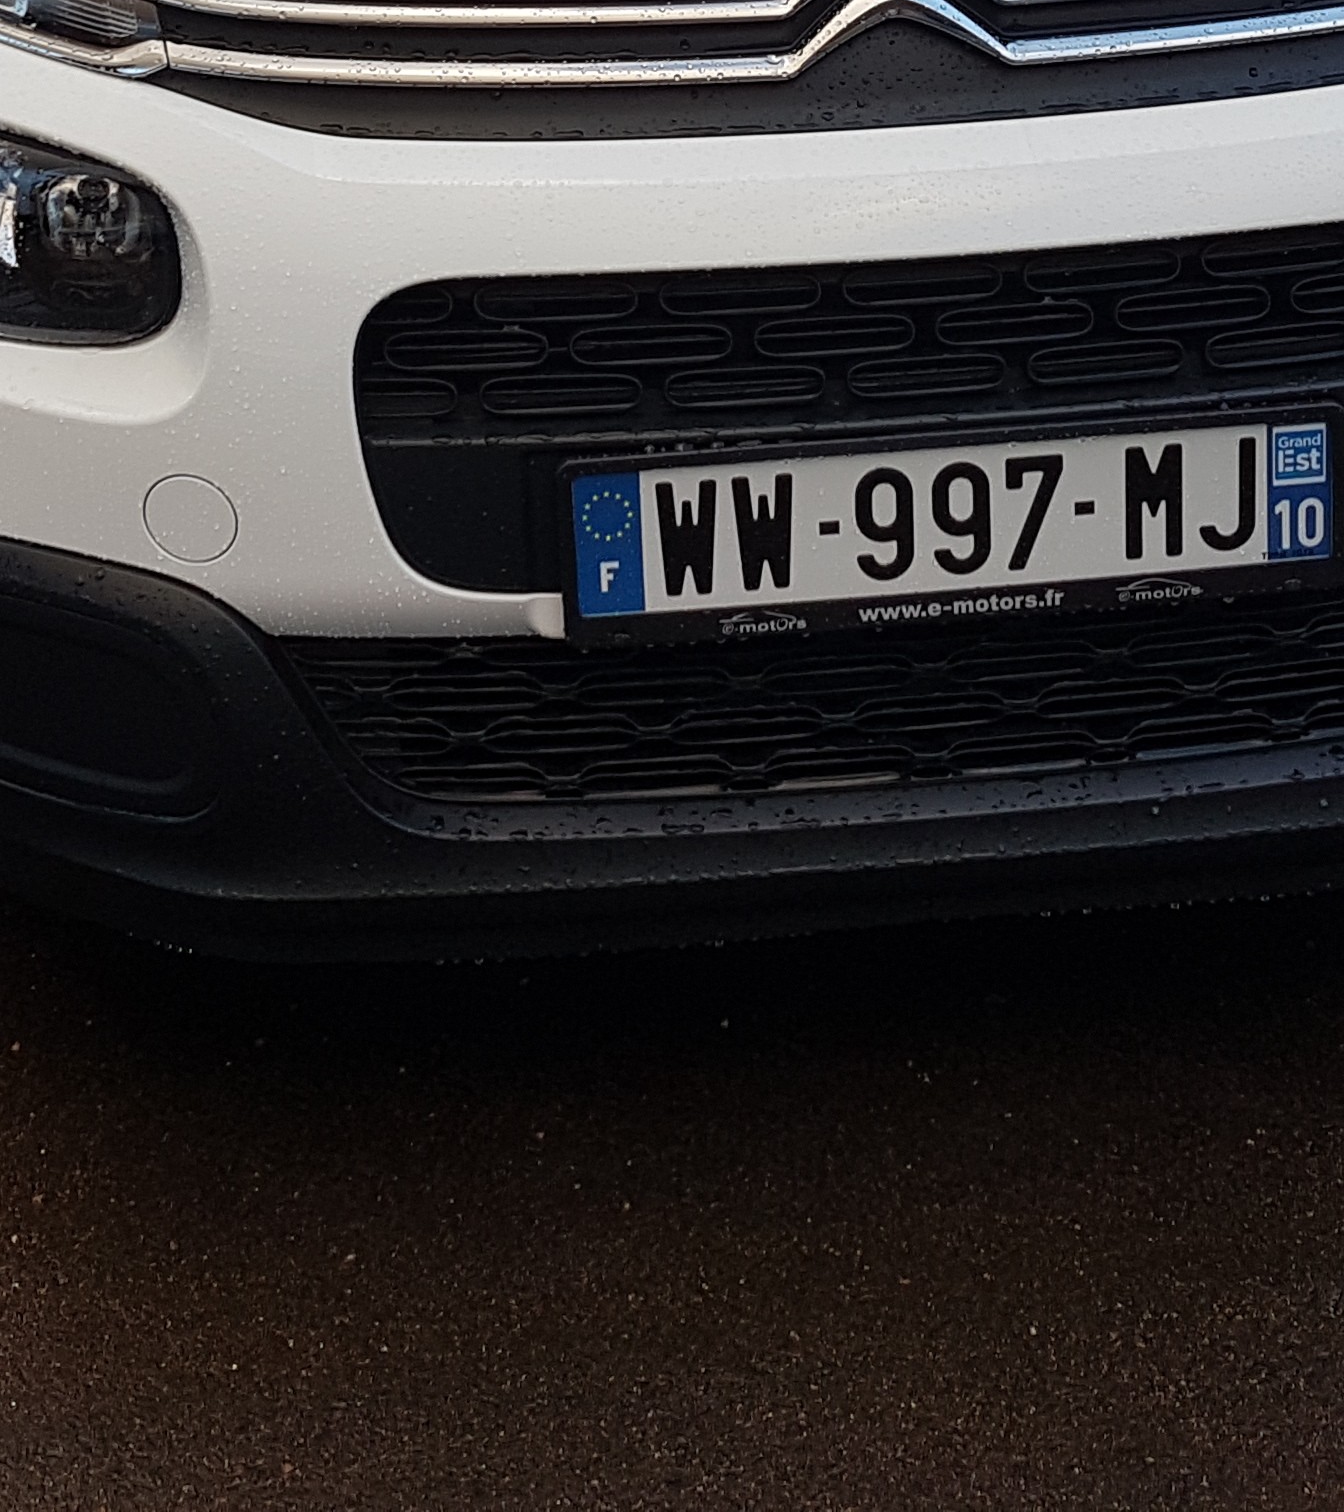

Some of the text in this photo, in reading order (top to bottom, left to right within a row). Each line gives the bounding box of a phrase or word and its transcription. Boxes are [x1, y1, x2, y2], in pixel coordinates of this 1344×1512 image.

[1278, 433, 1322, 449] Grand
[1277, 448, 1321, 473] Est
[654, 436, 1258, 597] WW-997-MJ
[1274, 497, 1324, 550] 10
[598, 561, 620, 593] F
[858, 589, 1065, 623] www.e-motors.fr
